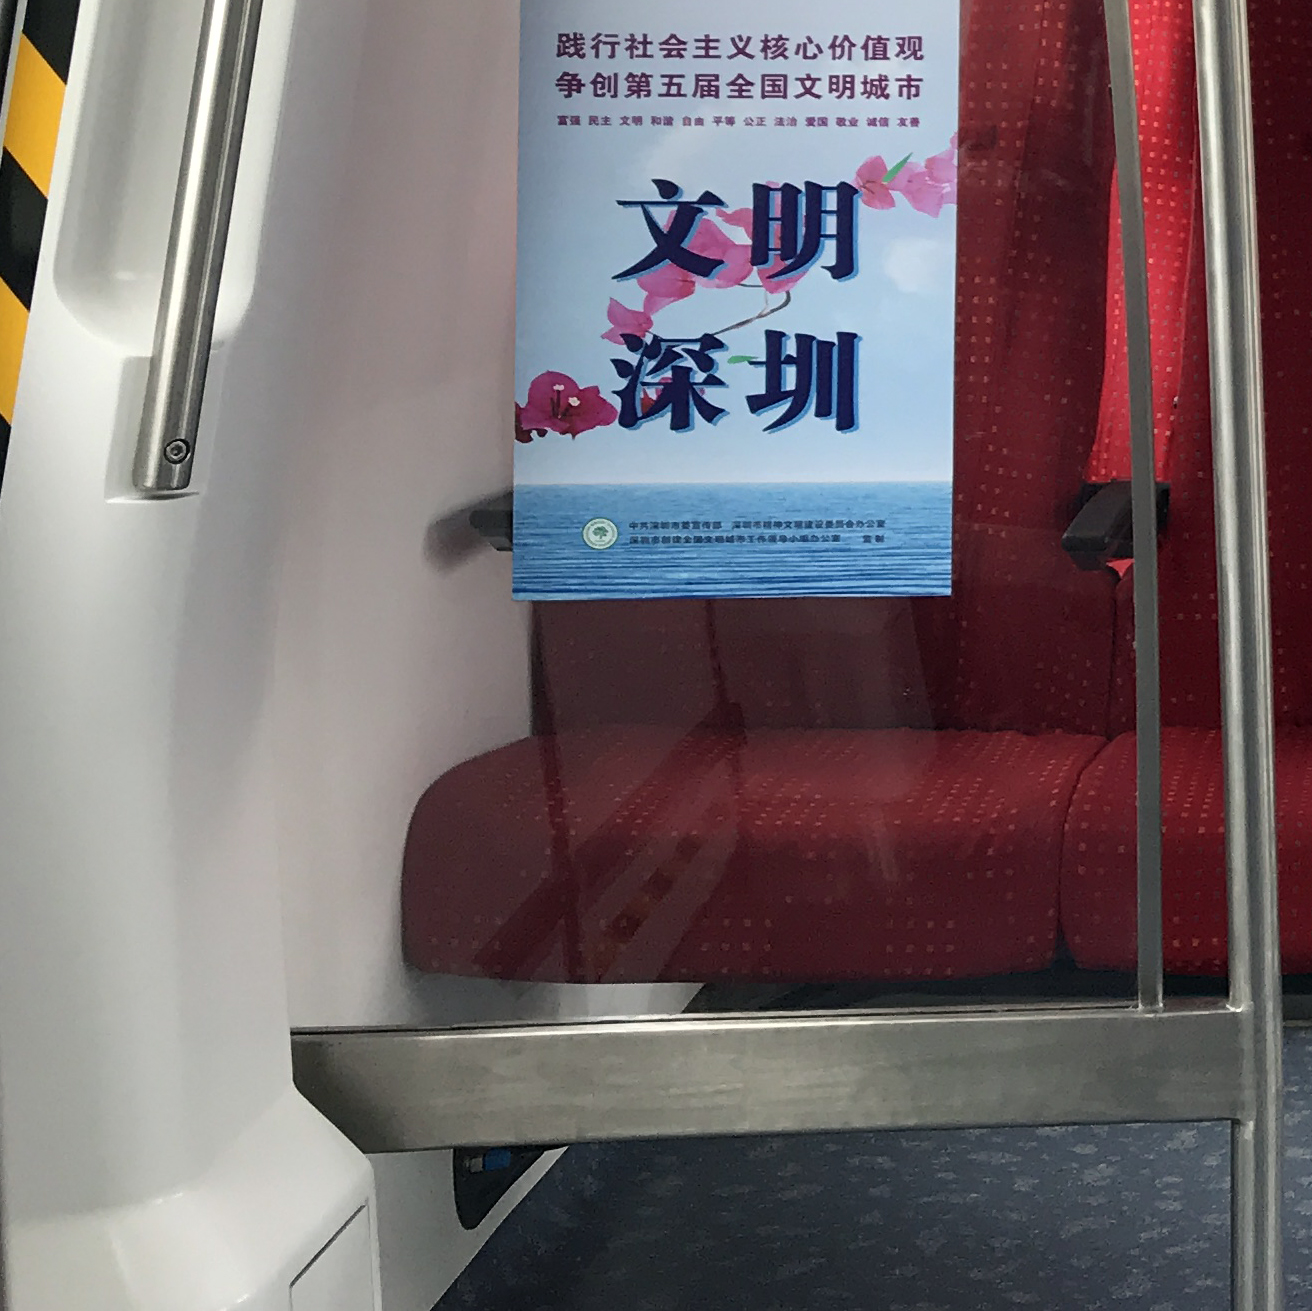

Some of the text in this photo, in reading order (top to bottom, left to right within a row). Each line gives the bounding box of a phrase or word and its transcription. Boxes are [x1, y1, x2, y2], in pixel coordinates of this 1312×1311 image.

[556, 32, 924, 61] 践行社会主义核心价值观
[555, 71, 924, 100] 争创第五届全国文明城市
[613, 178, 860, 282] 文明
[611, 329, 861, 433] 深圳
